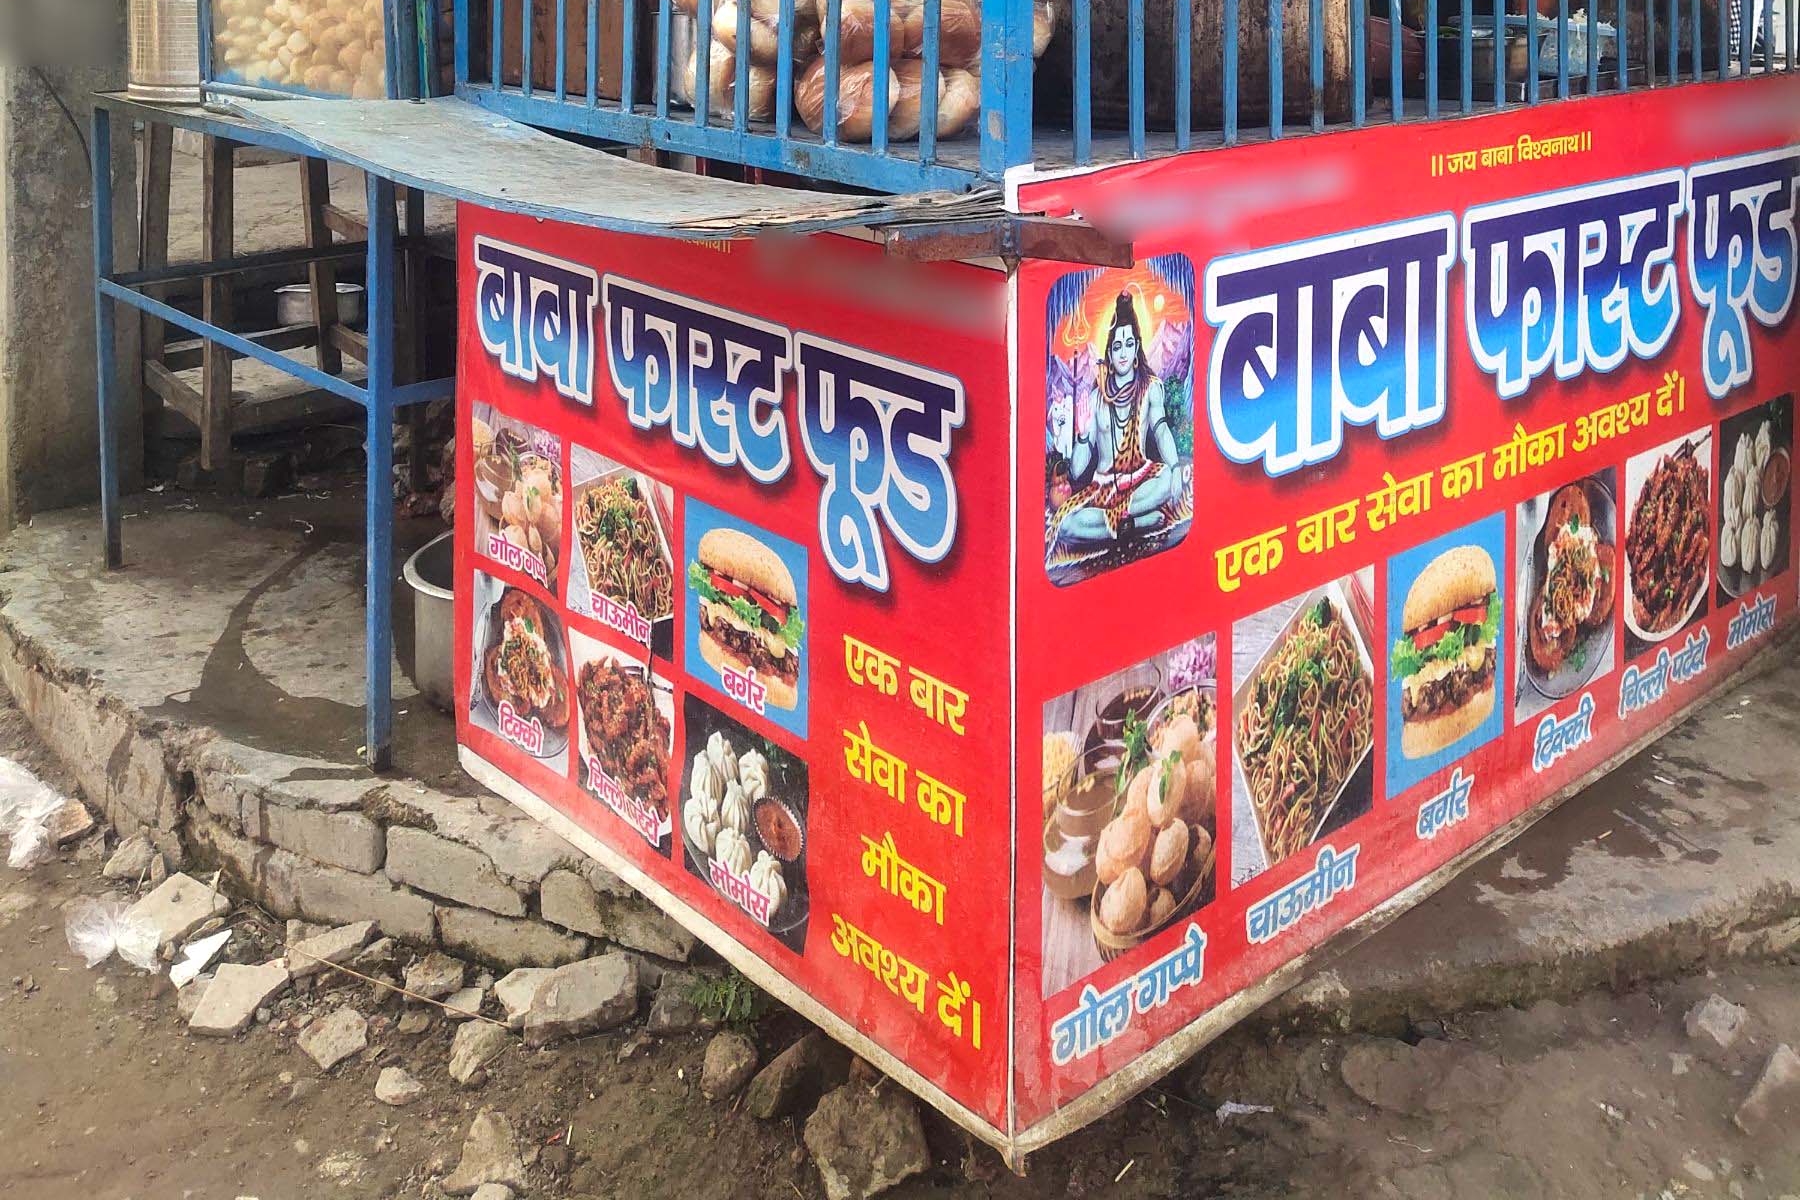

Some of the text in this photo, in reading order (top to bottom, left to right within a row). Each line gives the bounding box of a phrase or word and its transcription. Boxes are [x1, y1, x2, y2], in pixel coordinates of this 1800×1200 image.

[1481, 145, 1514, 167] बाबा
[1205, 145, 1800, 477] बाबा फास्ट फूड
[474, 234, 597, 406] बाबा
[602, 273, 792, 485] फास्ट
[794, 331, 964, 593] फूड
[1215, 525, 1287, 593] एक
[1296, 500, 1361, 554] बार
[1366, 472, 1432, 531] सेवा
[1441, 452, 1483, 500] का
[1492, 423, 1566, 481] मौका
[1572, 392, 1650, 450] अवश्य
[489, 531, 523, 570] गोल
[591, 592, 651, 648] चाऊमीन
[1727, 593, 1777, 650] मोमोस
[722, 665, 766, 715] बर्गर
[843, 634, 970, 736] एक बार
[1619, 647, 1670, 719] चिल्ली
[498, 700, 544, 755] टिक्की
[1533, 692, 1595, 772] टिक्की
[843, 721, 966, 837] सेवा का
[1416, 767, 1475, 839] बर्गर
[709, 859, 770, 927] मोमोस
[861, 832, 946, 926] मौका
[1246, 843, 1361, 944] चाऊमीन
[830, 914, 928, 1014] अवश्य
[1051, 923, 1208, 1066] गोल गप्पे
